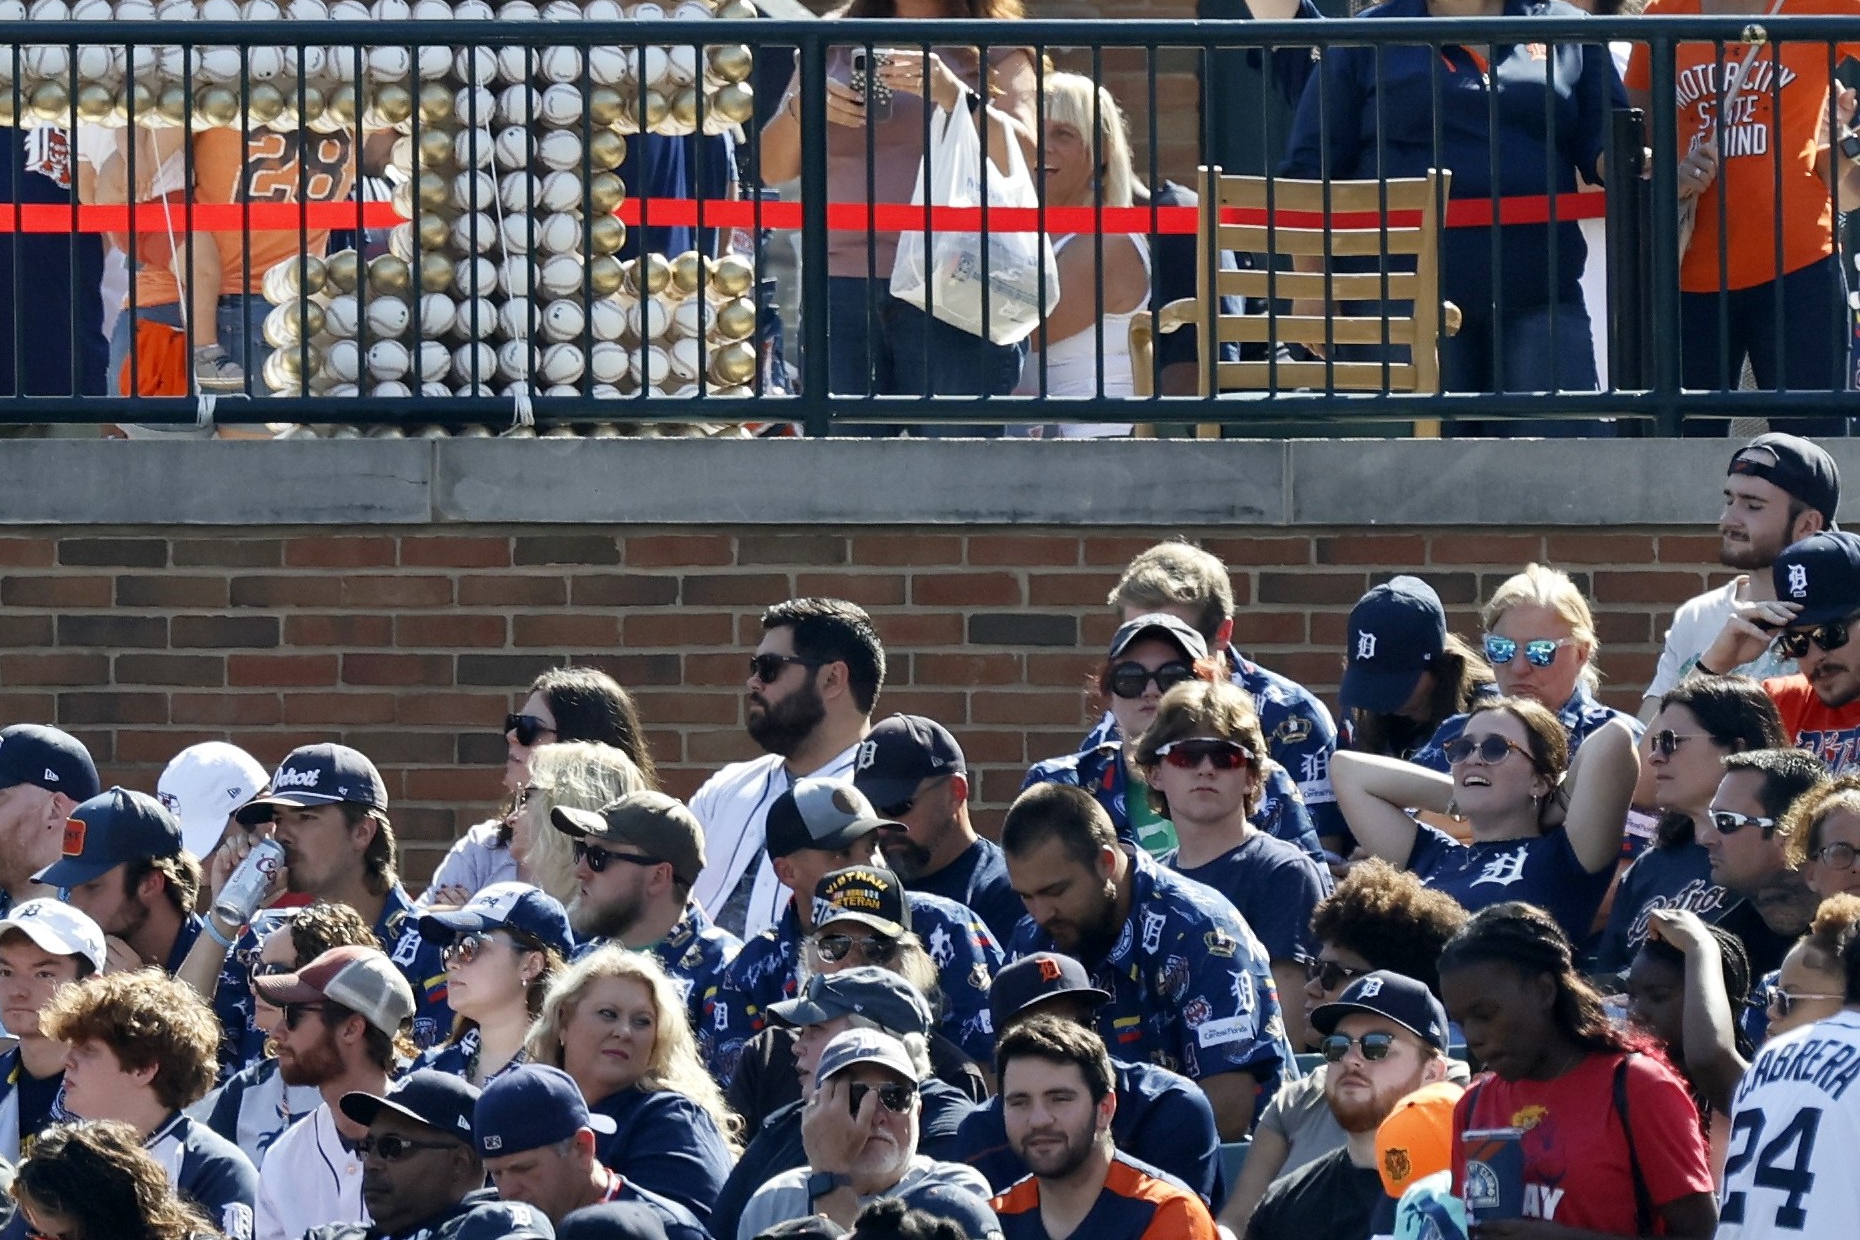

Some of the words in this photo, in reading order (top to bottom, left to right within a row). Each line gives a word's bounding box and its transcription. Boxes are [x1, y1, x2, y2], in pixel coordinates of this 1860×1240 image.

[1698, 95, 1758, 129] STE
[233, 124, 355, 203] 28
[1788, 564, 1808, 593] D
[1356, 629, 1377, 660] D
[857, 740, 878, 773] D
[272, 766, 321, 793] Detroit
[1470, 842, 1530, 888] D
[825, 870, 888, 895] VIETNAM
[1036, 959, 1061, 981] D
[1356, 977, 1384, 1000] D
[1738, 1040, 1860, 1103] CABRERA
[1720, 1106, 1824, 1231] 24
